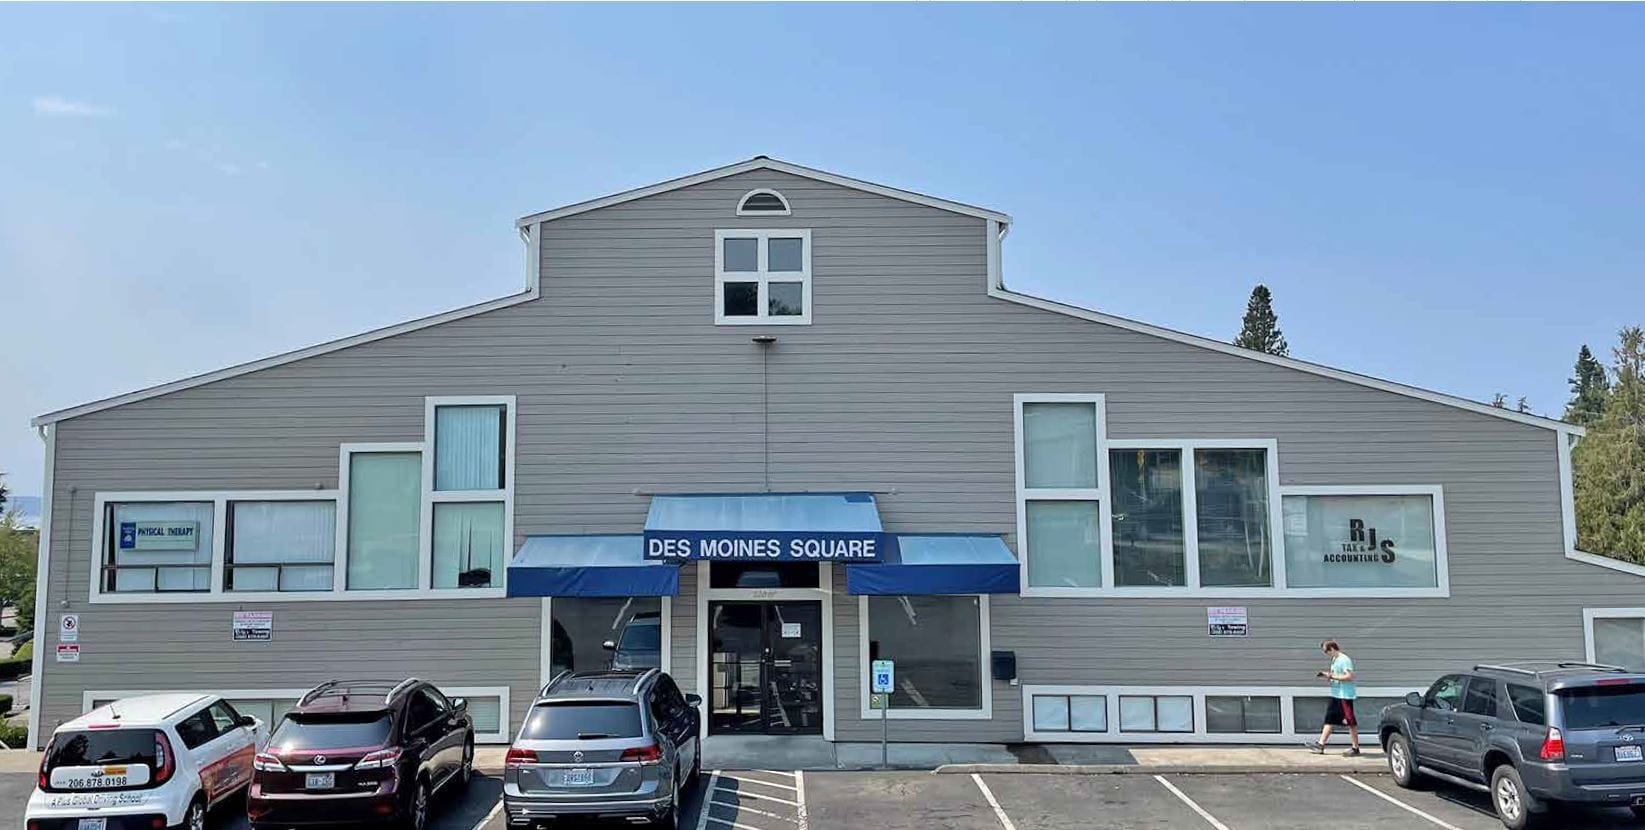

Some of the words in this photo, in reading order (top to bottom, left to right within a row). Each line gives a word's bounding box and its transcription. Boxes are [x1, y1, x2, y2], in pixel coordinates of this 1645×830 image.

[138, 527, 164, 536] PHYSICAL
[168, 527, 194, 536] THERAPY
[648, 539, 691, 557] DES
[700, 539, 781, 557] MOINES
[790, 539, 876, 558] SQUARE
[1341, 543, 1358, 552] TAX
[1360, 543, 1366, 552] &
[1323, 554, 1379, 563] ACCOUNTING
[118, 793, 142, 804] School
